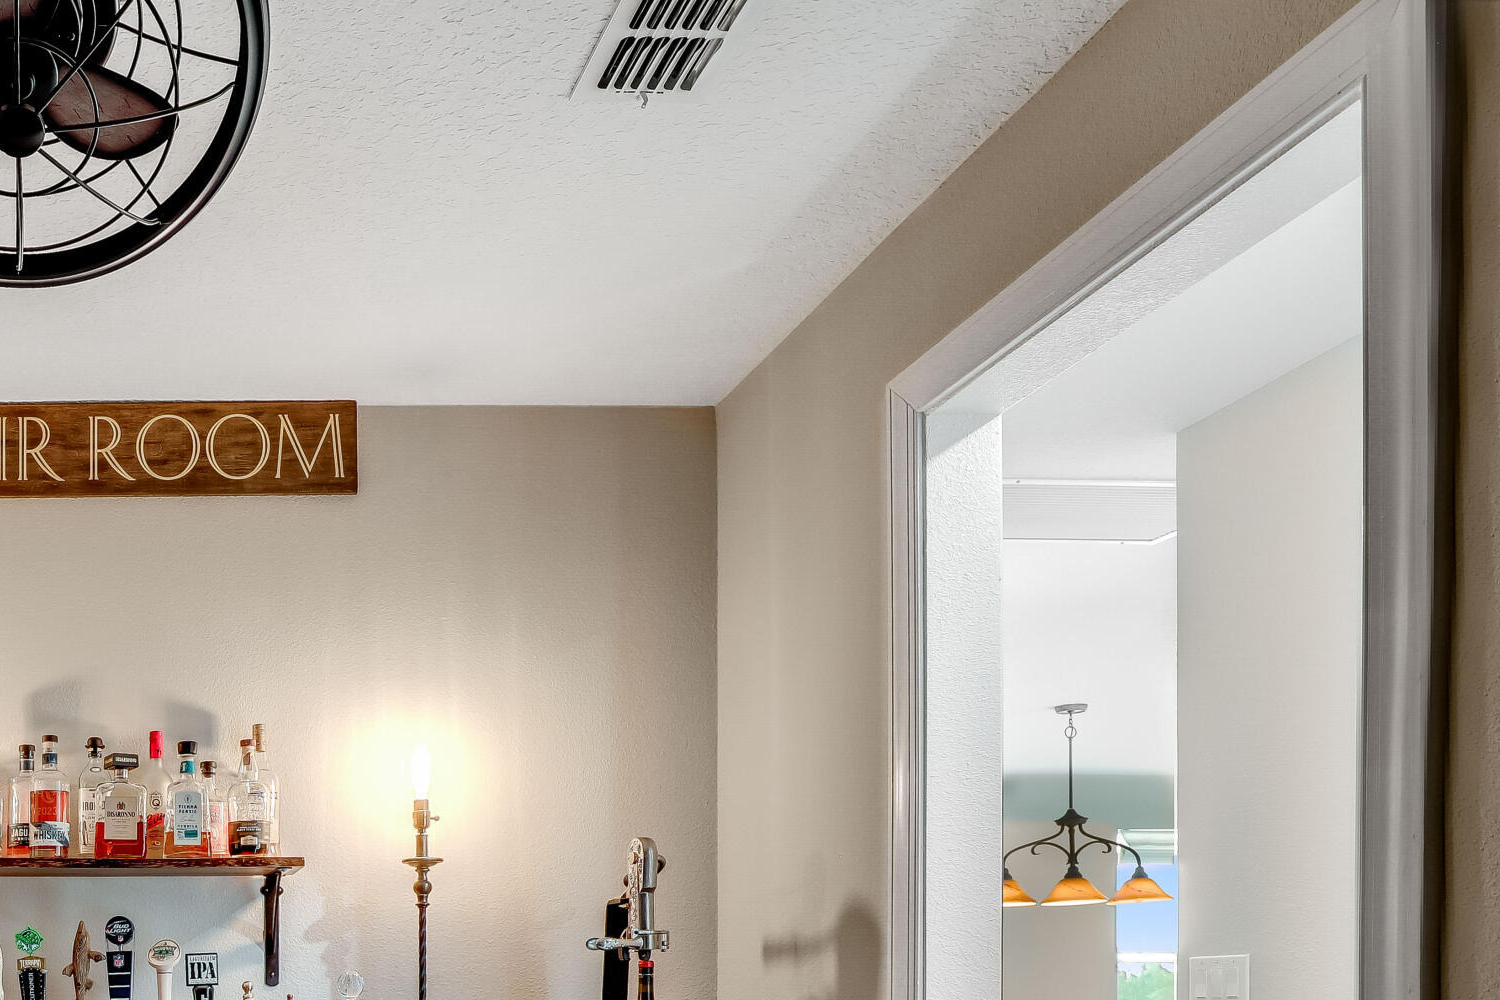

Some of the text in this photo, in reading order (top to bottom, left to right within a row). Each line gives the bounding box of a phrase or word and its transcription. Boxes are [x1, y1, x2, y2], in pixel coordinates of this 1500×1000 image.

[88, 413, 346, 481] ROOM
[11, 828, 29, 838] JAGU
[33, 830, 67, 841] WHISKEY
[189, 961, 216, 980] IPA
